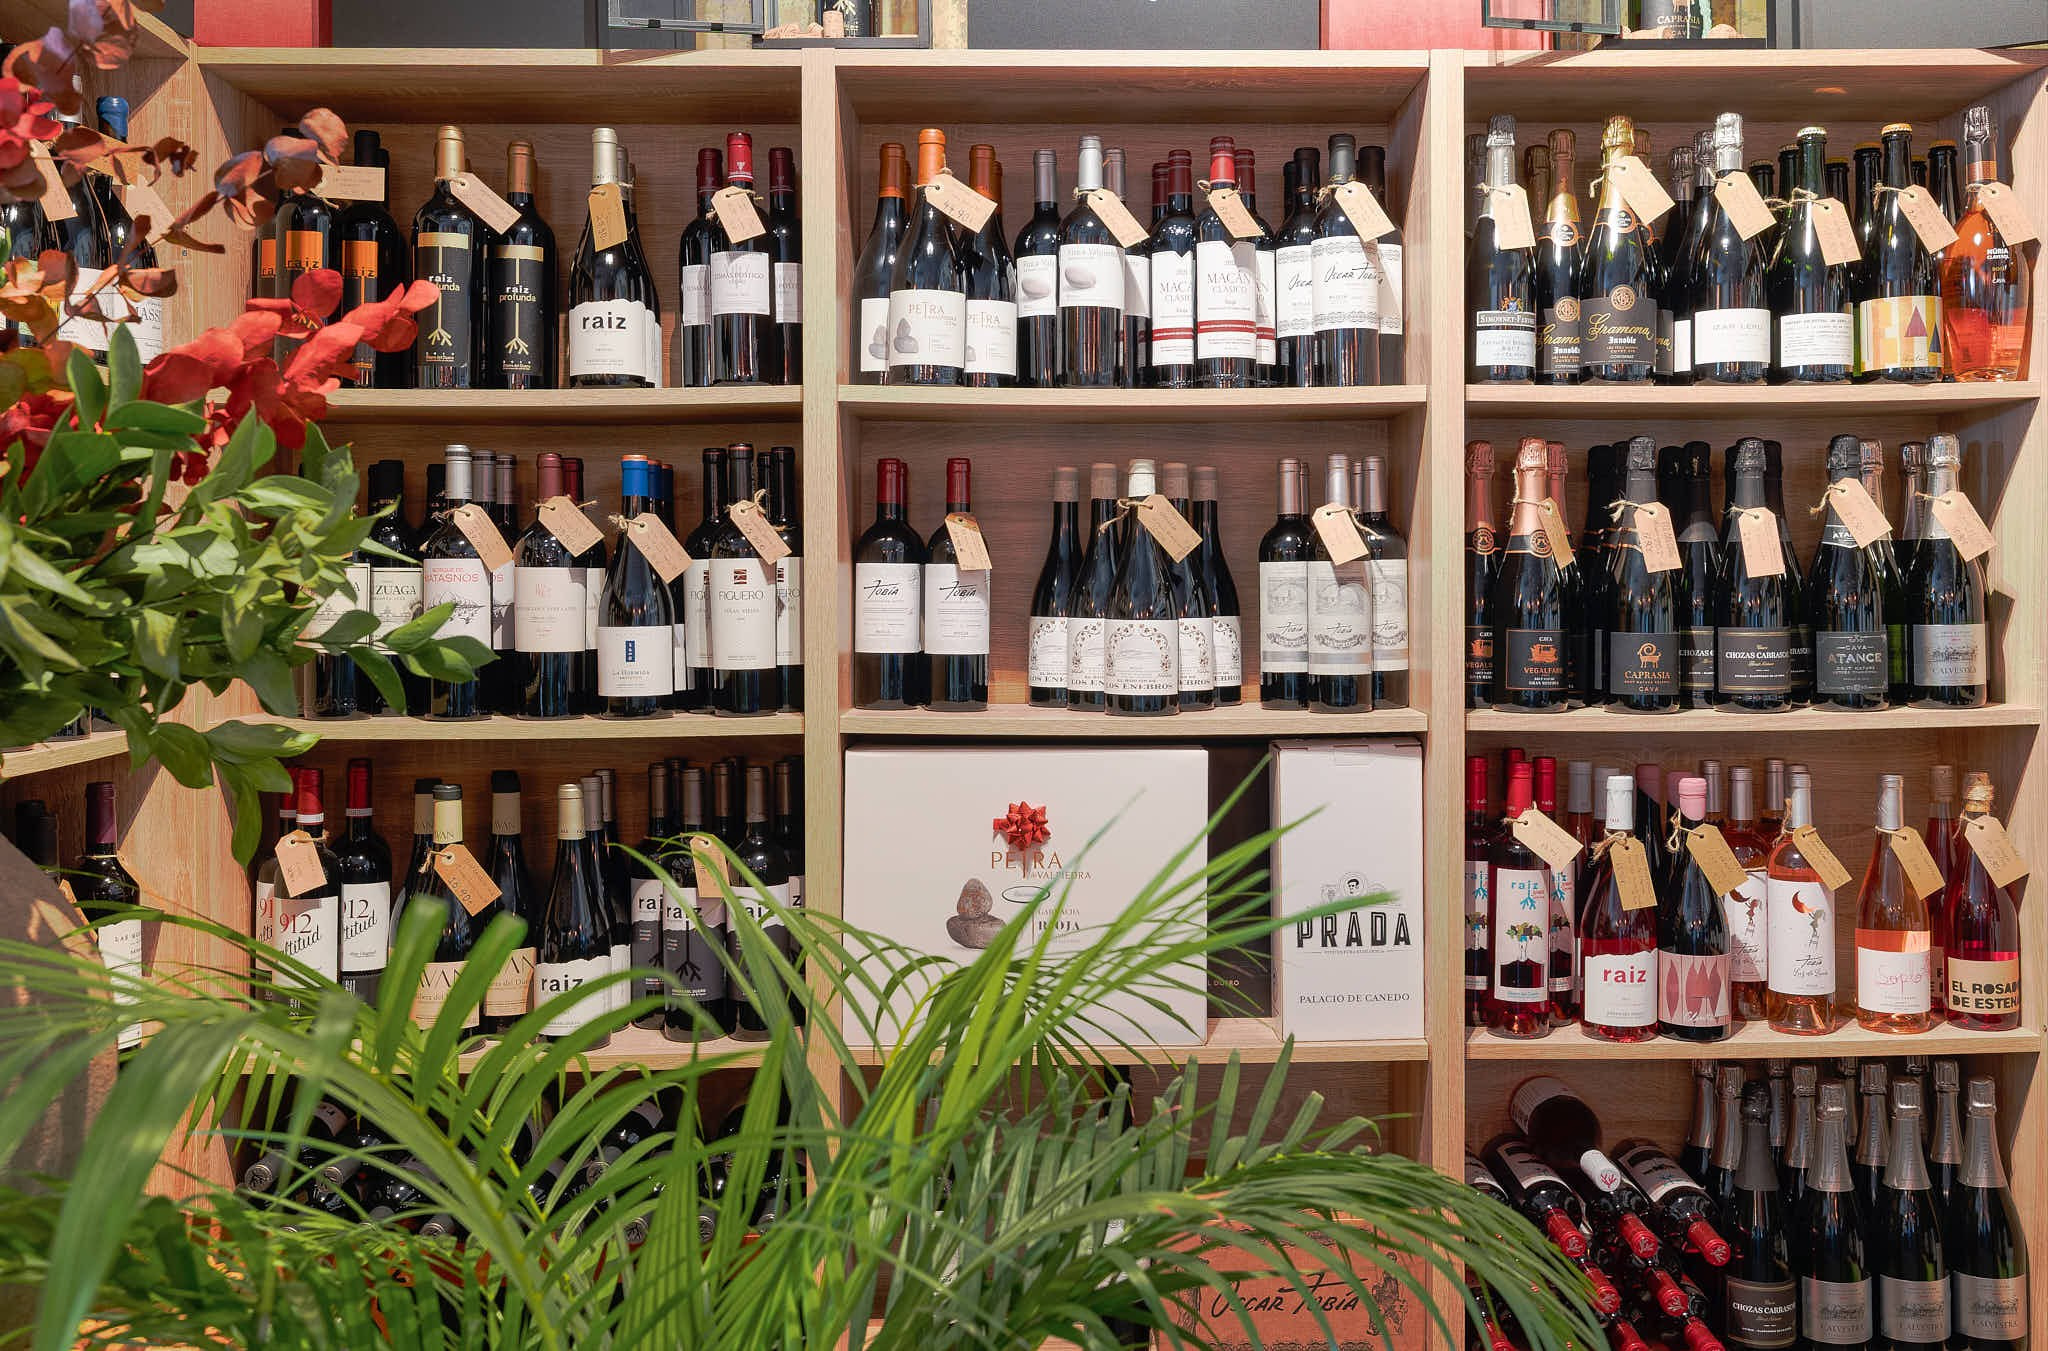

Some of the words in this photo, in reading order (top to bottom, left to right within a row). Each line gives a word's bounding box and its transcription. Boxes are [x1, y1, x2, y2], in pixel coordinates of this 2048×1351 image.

[1657, 15, 1700, 24] CAPRASIA
[1986, 247, 2009, 255] NÚRIA
[287, 257, 320, 269] raiz
[429, 273, 453, 283] raiz
[506, 285, 529, 294] raiz
[499, 293, 536, 303] profunda
[582, 311, 627, 330] raiz
[1586, 312, 1654, 341] Gramona
[1608, 336, 1637, 344] Innoble
[719, 590, 765, 601] FIGUERO
[1725, 651, 1755, 659] CHOZAS
[1827, 653, 1882, 663] ATANCE
[1624, 671, 1671, 679] CAPRASIA
[280, 914, 312, 933] 912
[1038, 921, 1080, 931] ROJA
[1296, 911, 1411, 948] PRADA
[1603, 965, 1648, 983] raiz
[1951, 980, 1967, 993] EL
[1299, 995, 1344, 1004] PALACIO
[1347, 995, 1361, 1003] DE
[1364, 992, 1410, 1002] CANEDO
[1952, 994, 1970, 1008] DE
[1732, 1301, 1763, 1314] CHOZAS
